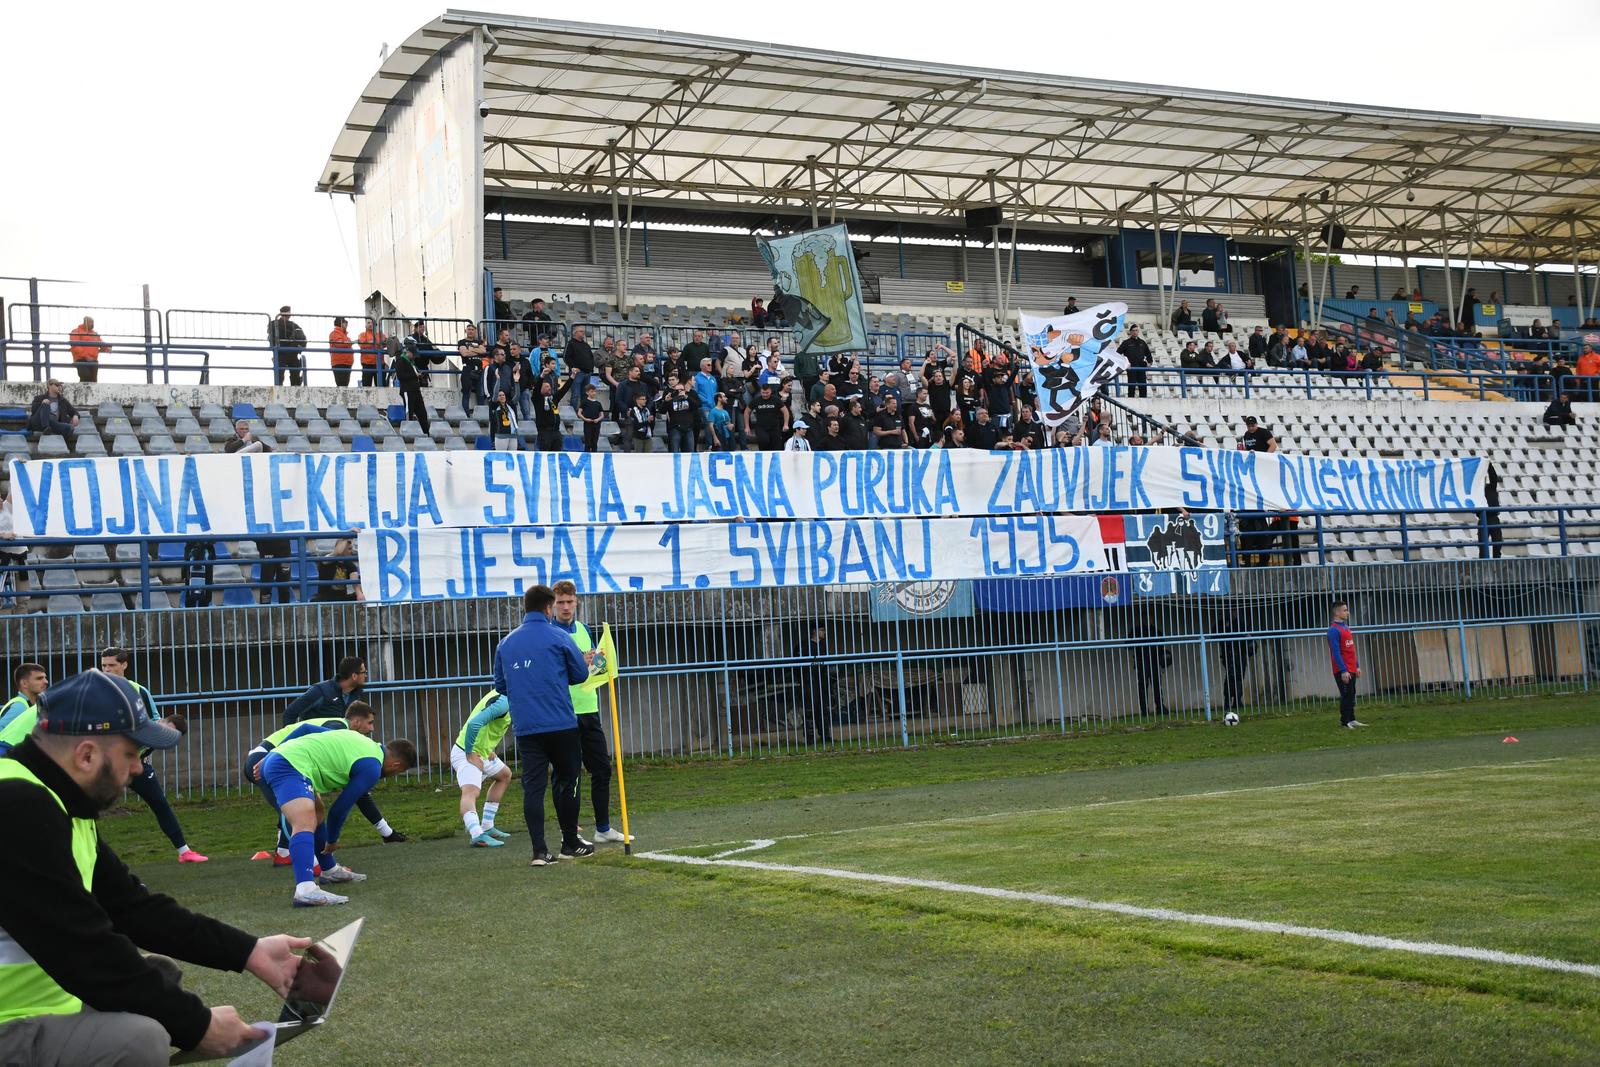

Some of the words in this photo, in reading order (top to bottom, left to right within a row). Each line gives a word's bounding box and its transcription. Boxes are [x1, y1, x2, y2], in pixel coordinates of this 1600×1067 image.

[14, 457, 212, 536] VOJNA
[240, 452, 443, 532] LEKCIJA
[484, 452, 646, 525] SVIMA,
[661, 451, 795, 518] JASNA
[813, 450, 960, 515] PORUKA
[988, 446, 1151, 513] ZAUVIJEK
[1180, 447, 1265, 510] SVIM
[1278, 455, 1481, 511] DUŠMANIMA!
[659, 522, 714, 589] 1.
[728, 520, 933, 587] SVIBANJ
[969, 515, 1095, 576] 1995.
